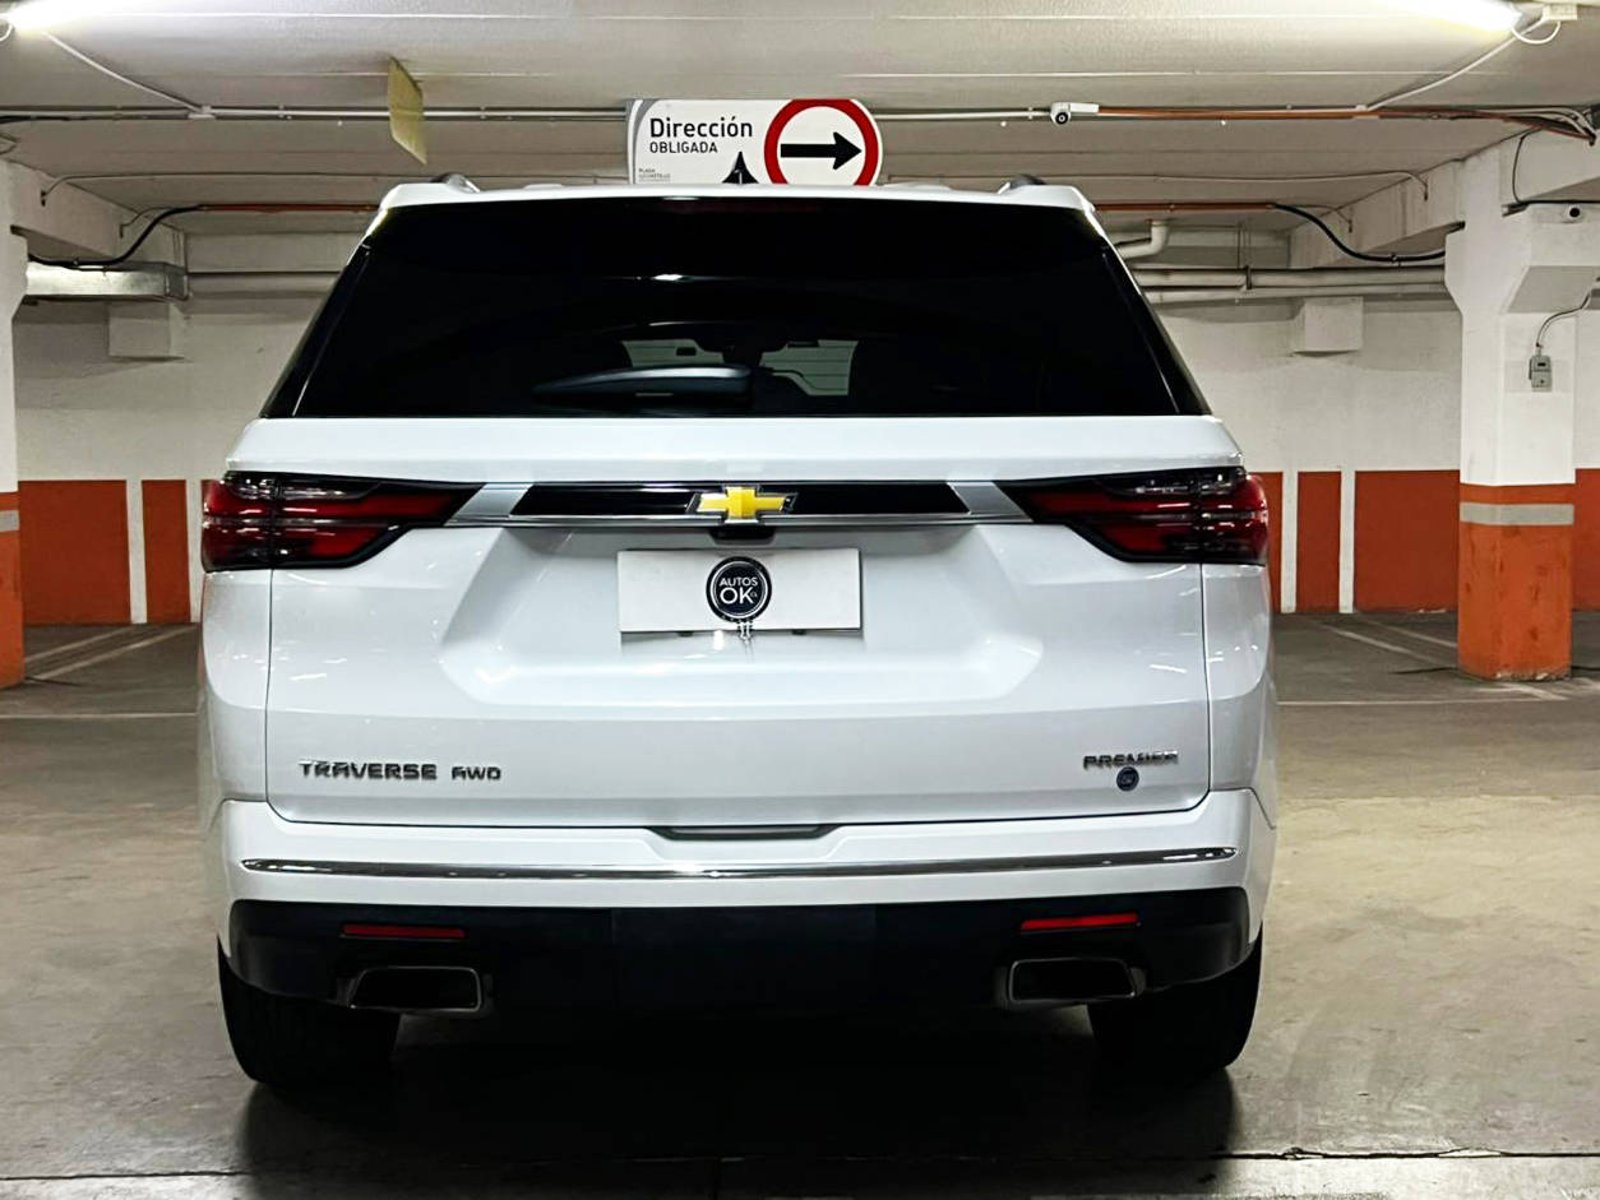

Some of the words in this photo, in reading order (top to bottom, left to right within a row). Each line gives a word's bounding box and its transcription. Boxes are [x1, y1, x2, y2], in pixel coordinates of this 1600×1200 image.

[650, 116, 753, 138] Dirección
[650, 141, 718, 154] OBLIGADA
[719, 577, 758, 587] AUTOS
[720, 586, 754, 605] OK
[1083, 751, 1178, 770] PREMIER
[299, 760, 437, 781] TRAVERSE
[451, 765, 502, 781] AWD
